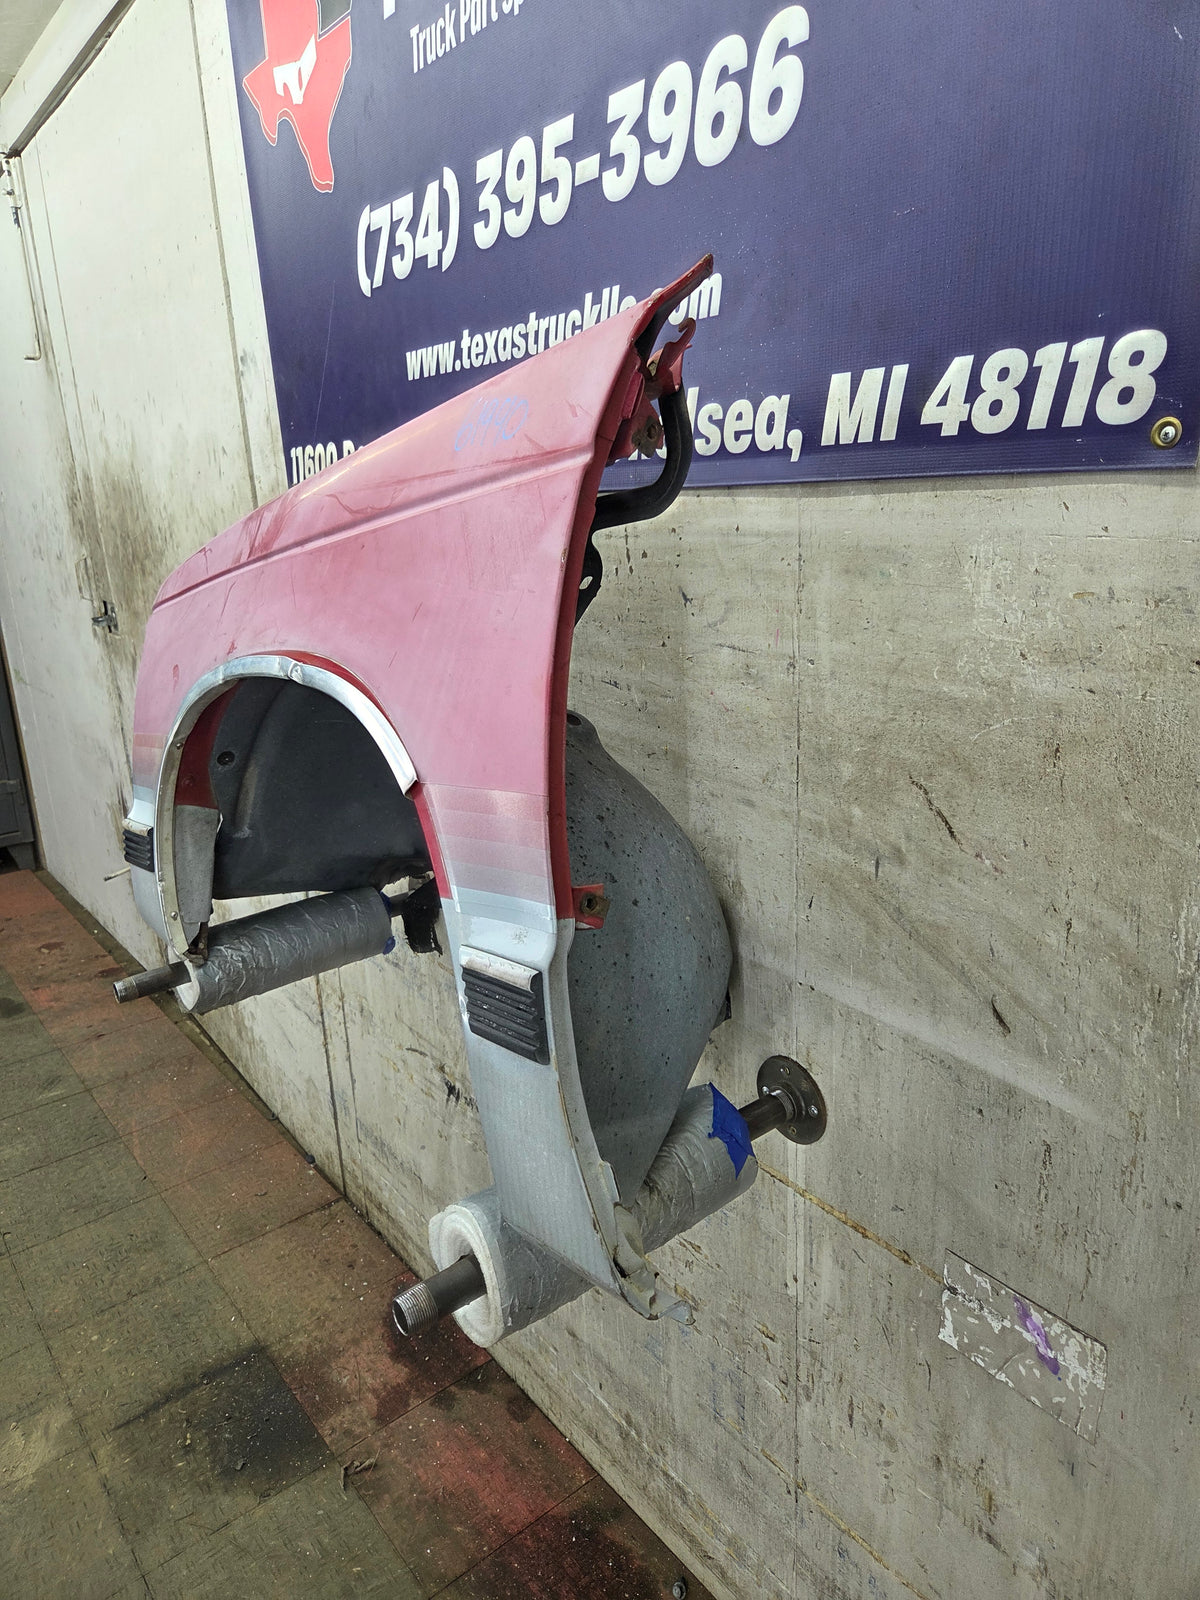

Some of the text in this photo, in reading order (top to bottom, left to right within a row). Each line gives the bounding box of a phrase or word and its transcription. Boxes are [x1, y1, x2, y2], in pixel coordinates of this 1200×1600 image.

[409, 2, 456, 74] Truck
[357, 5, 810, 298] (734) 395-3966
[290, 441, 338, 485] 11600
[821, 363, 909, 446] MI
[920, 329, 1167, 437] 48118
